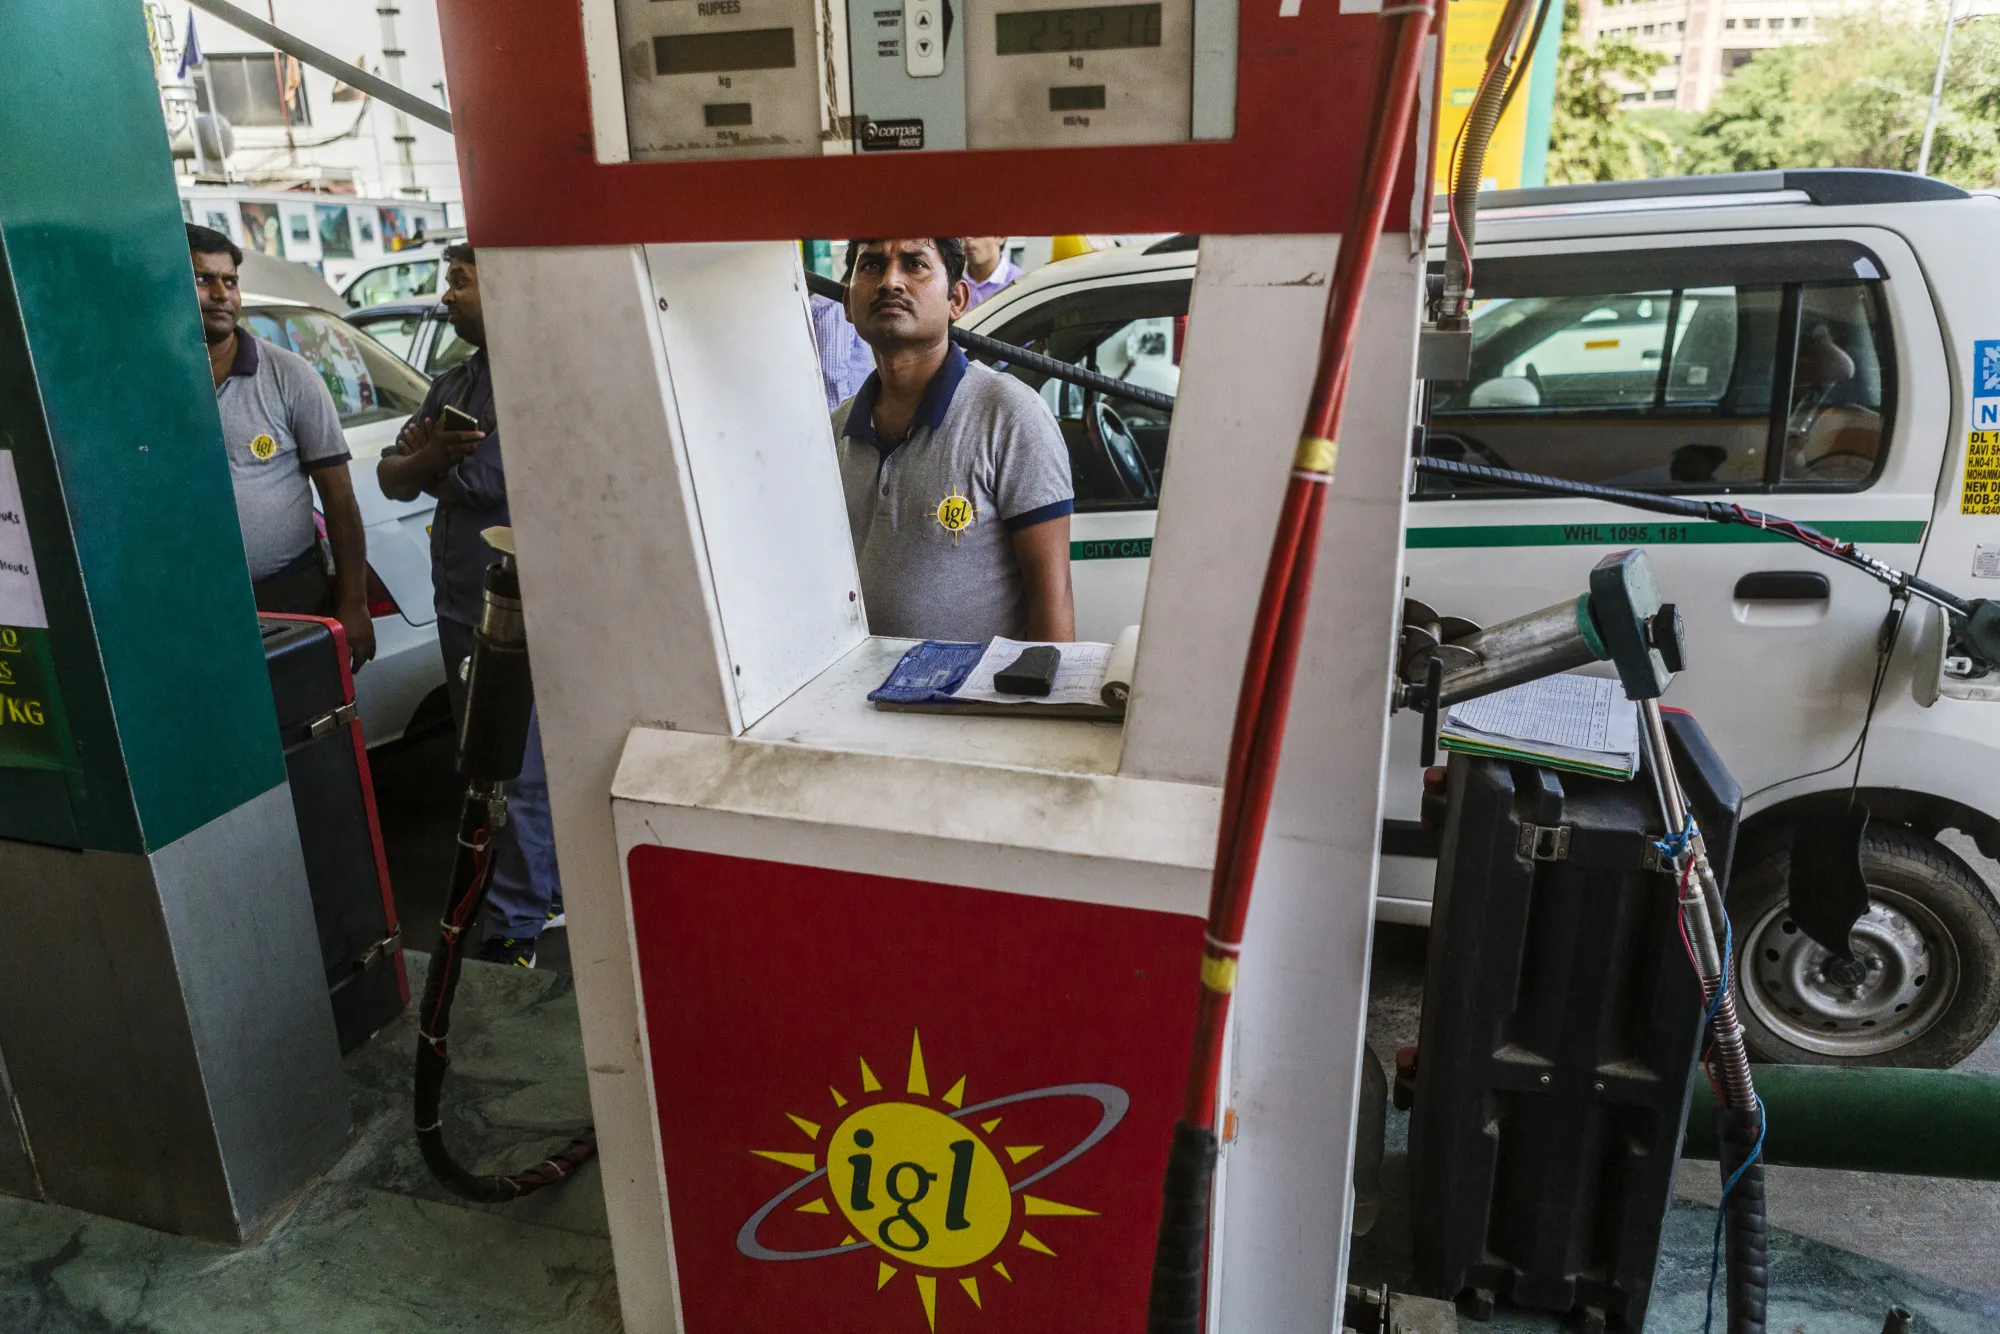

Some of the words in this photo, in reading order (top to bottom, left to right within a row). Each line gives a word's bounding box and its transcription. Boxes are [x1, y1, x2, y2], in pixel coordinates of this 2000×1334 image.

[698, 1, 741, 16] RUPEES
[878, 19, 899, 27] PRESET
[878, 40, 899, 48] PRESET
[878, 49, 899, 57] RECALL
[1068, 56, 1084, 70] kg
[718, 76, 732, 88] kg
[878, 125, 922, 139] compac
[898, 138, 922, 148] INSIDE
[1971, 432, 1988, 443] DL
[256, 436, 273, 457] igl
[1969, 444, 1989, 456] RAVI
[1965, 481, 1988, 493] NEW
[944, 498, 968, 529] igl
[1563, 526, 1603, 541] WHL
[1608, 526, 1653, 543] 1095,
[1658, 526, 1687, 541] 181
[1084, 543, 1117, 557] CITY
[1120, 541, 1151, 556] CAB
[847, 1128, 976, 1252] igl
